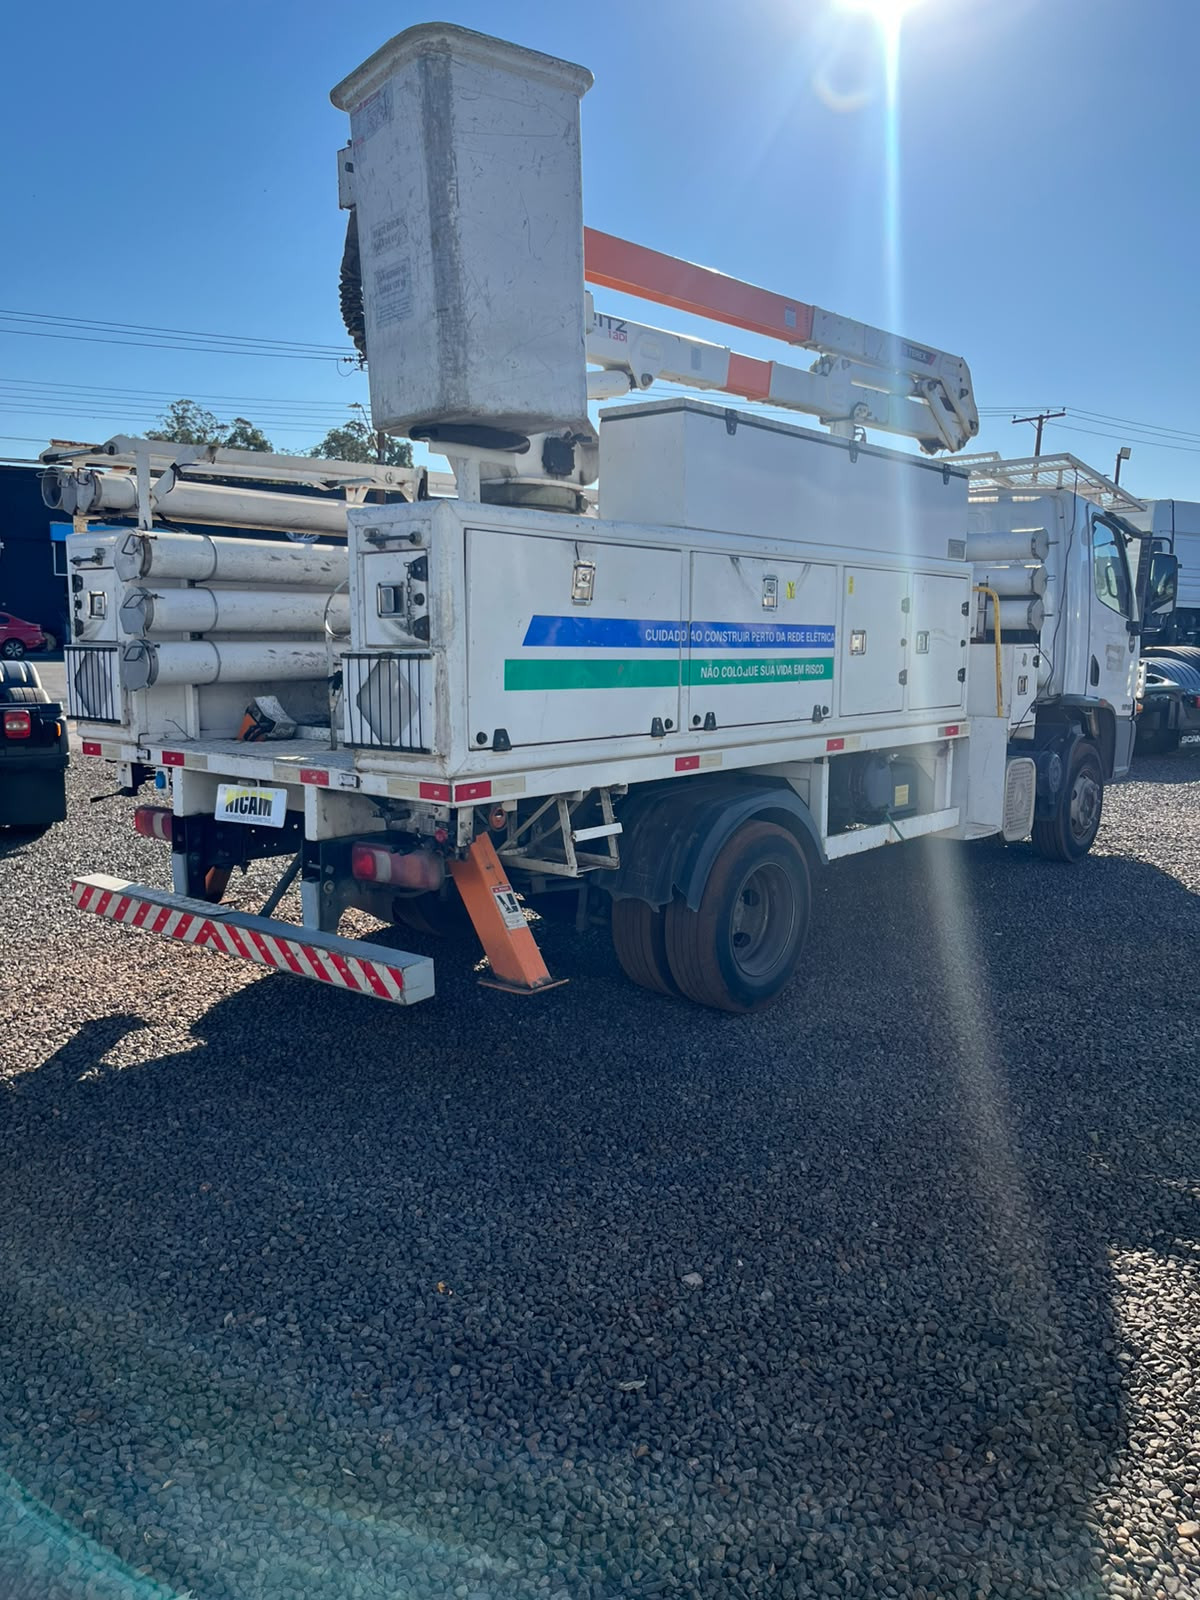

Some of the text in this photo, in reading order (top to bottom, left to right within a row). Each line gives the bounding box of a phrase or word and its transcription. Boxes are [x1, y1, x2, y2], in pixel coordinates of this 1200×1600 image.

[593, 312, 627, 333] ITZ
[645, 629, 687, 641] CUIDADO
[690, 631, 702, 642] AO
[704, 631, 750, 642] CONSTRUIR
[752, 631, 775, 643] PERTO
[776, 632, 786, 643] DA
[787, 632, 805, 643] REDE
[700, 664, 720, 678] NÃO
[760, 664, 775, 676] SUA
[776, 664, 792, 676] VIDA
[793, 664, 804, 675] EM
[805, 664, 824, 675] RISCO
[225, 788, 273, 817] NICAM
